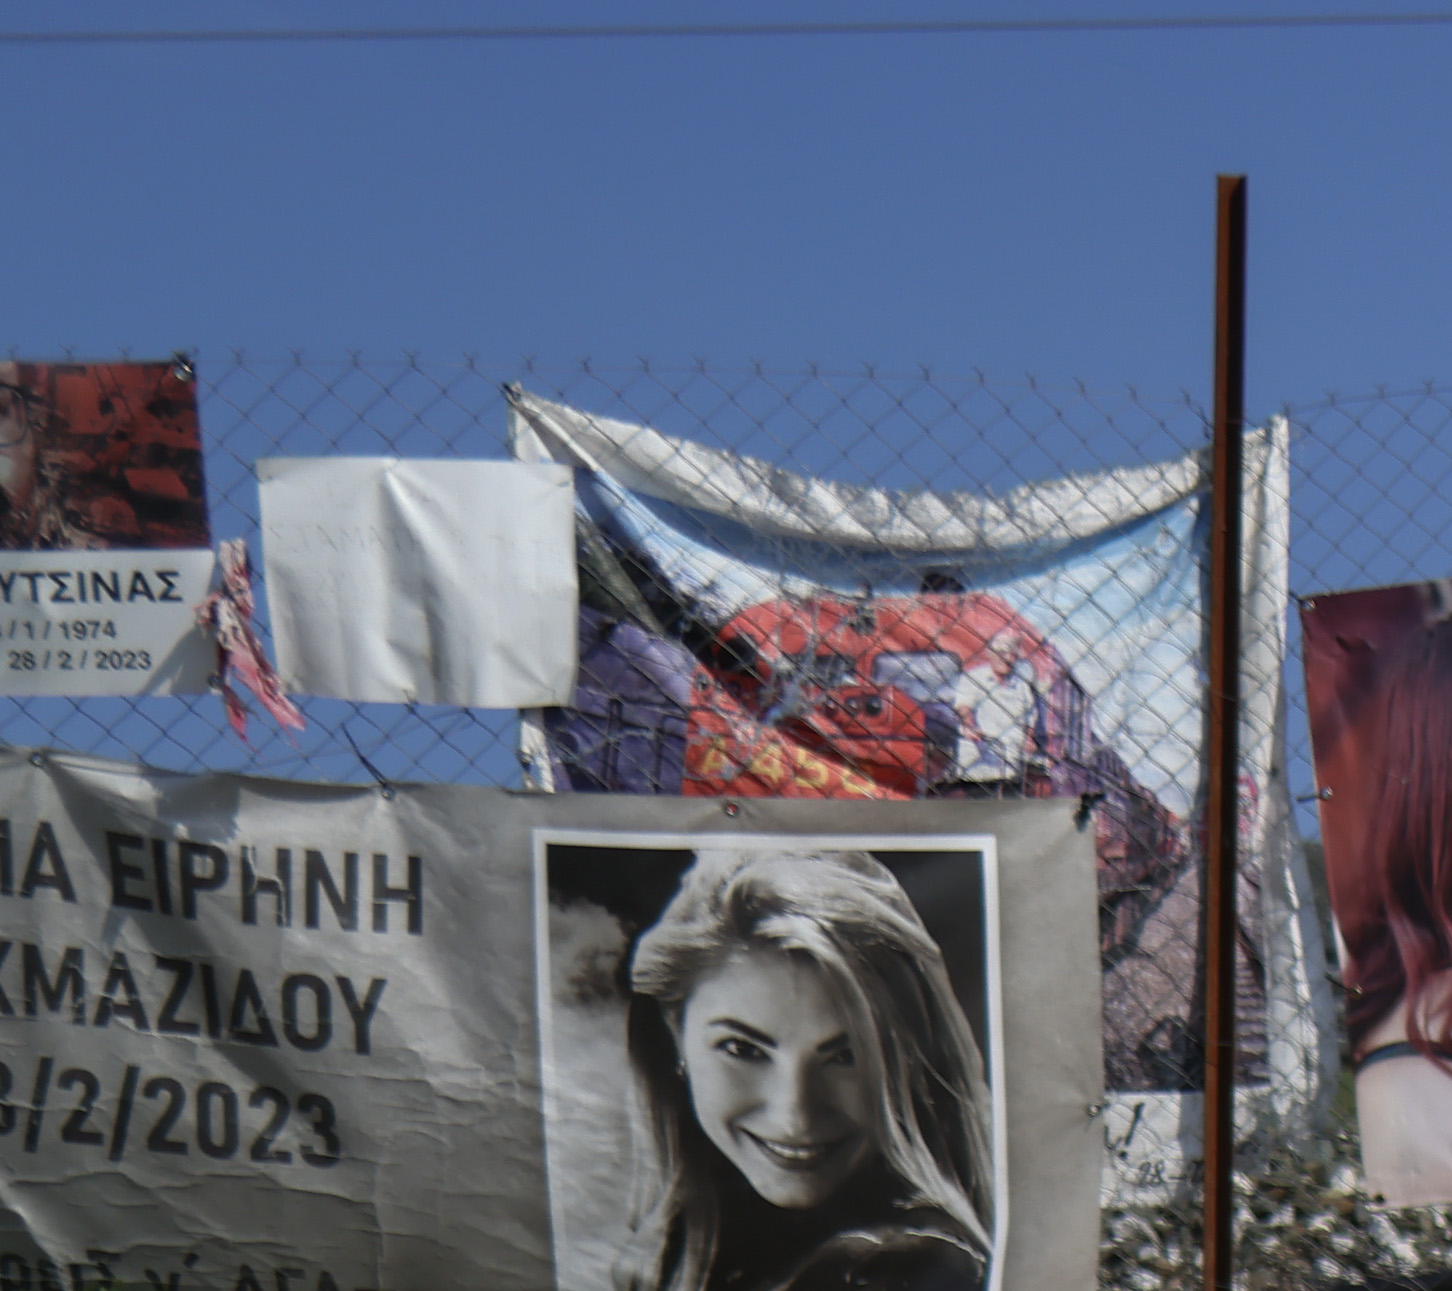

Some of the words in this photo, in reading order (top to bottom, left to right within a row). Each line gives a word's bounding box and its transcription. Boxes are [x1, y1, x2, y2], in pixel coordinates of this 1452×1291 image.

[58, 620, 117, 640] 1974
[95, 650, 153, 671] 2023
[105, 829, 424, 937] ΕΙΡΗΝΗ
